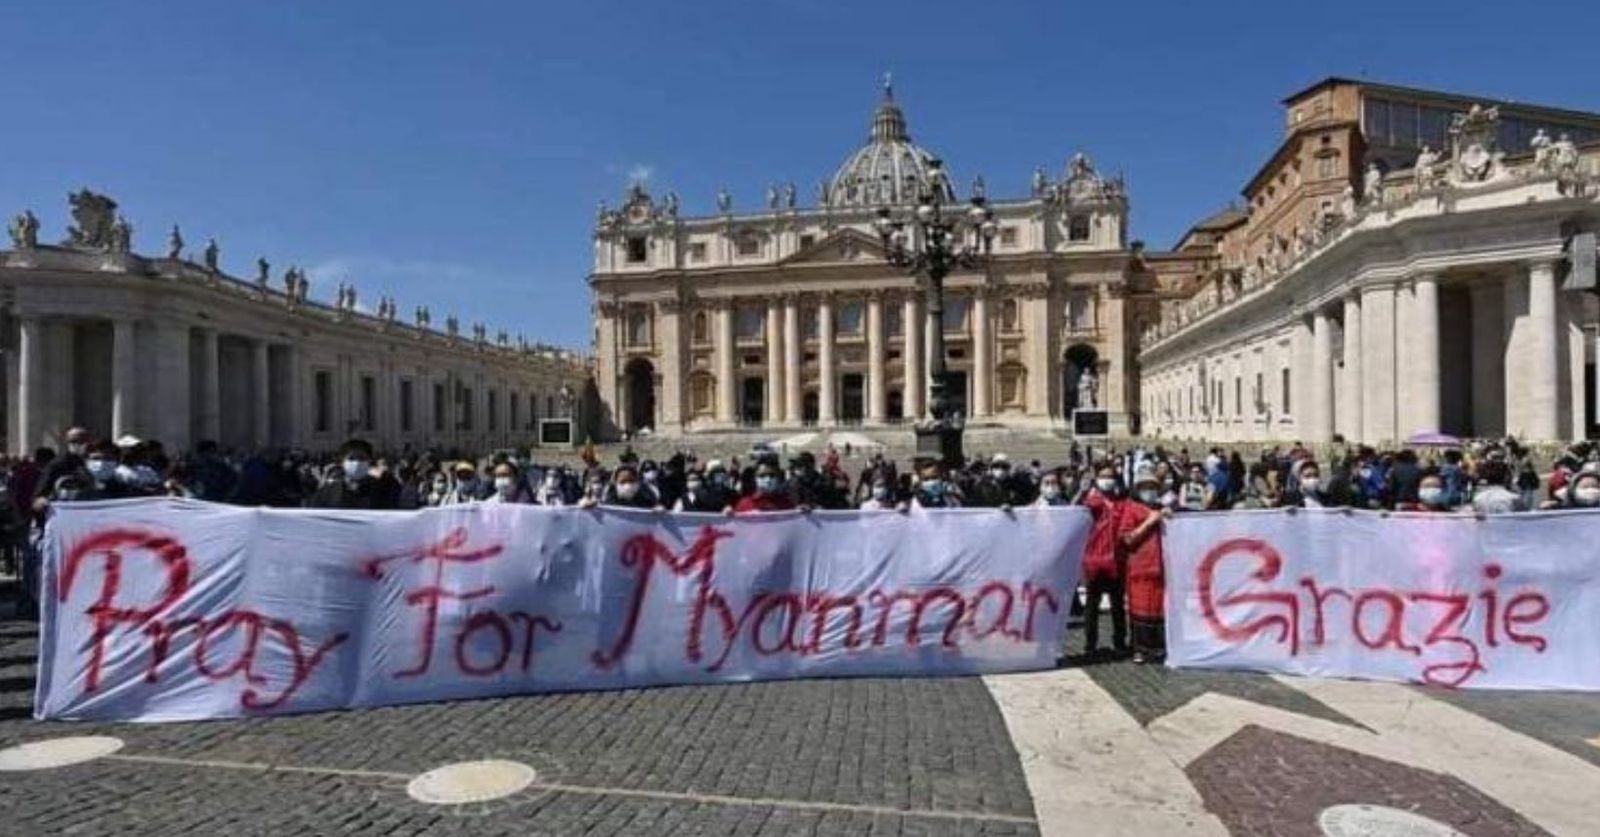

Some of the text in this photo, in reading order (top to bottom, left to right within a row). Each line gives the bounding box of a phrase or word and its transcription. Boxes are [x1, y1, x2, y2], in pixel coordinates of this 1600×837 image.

[58, 525, 1058, 711] Pray For Myanmar
[1197, 538, 1551, 688] Grazie
